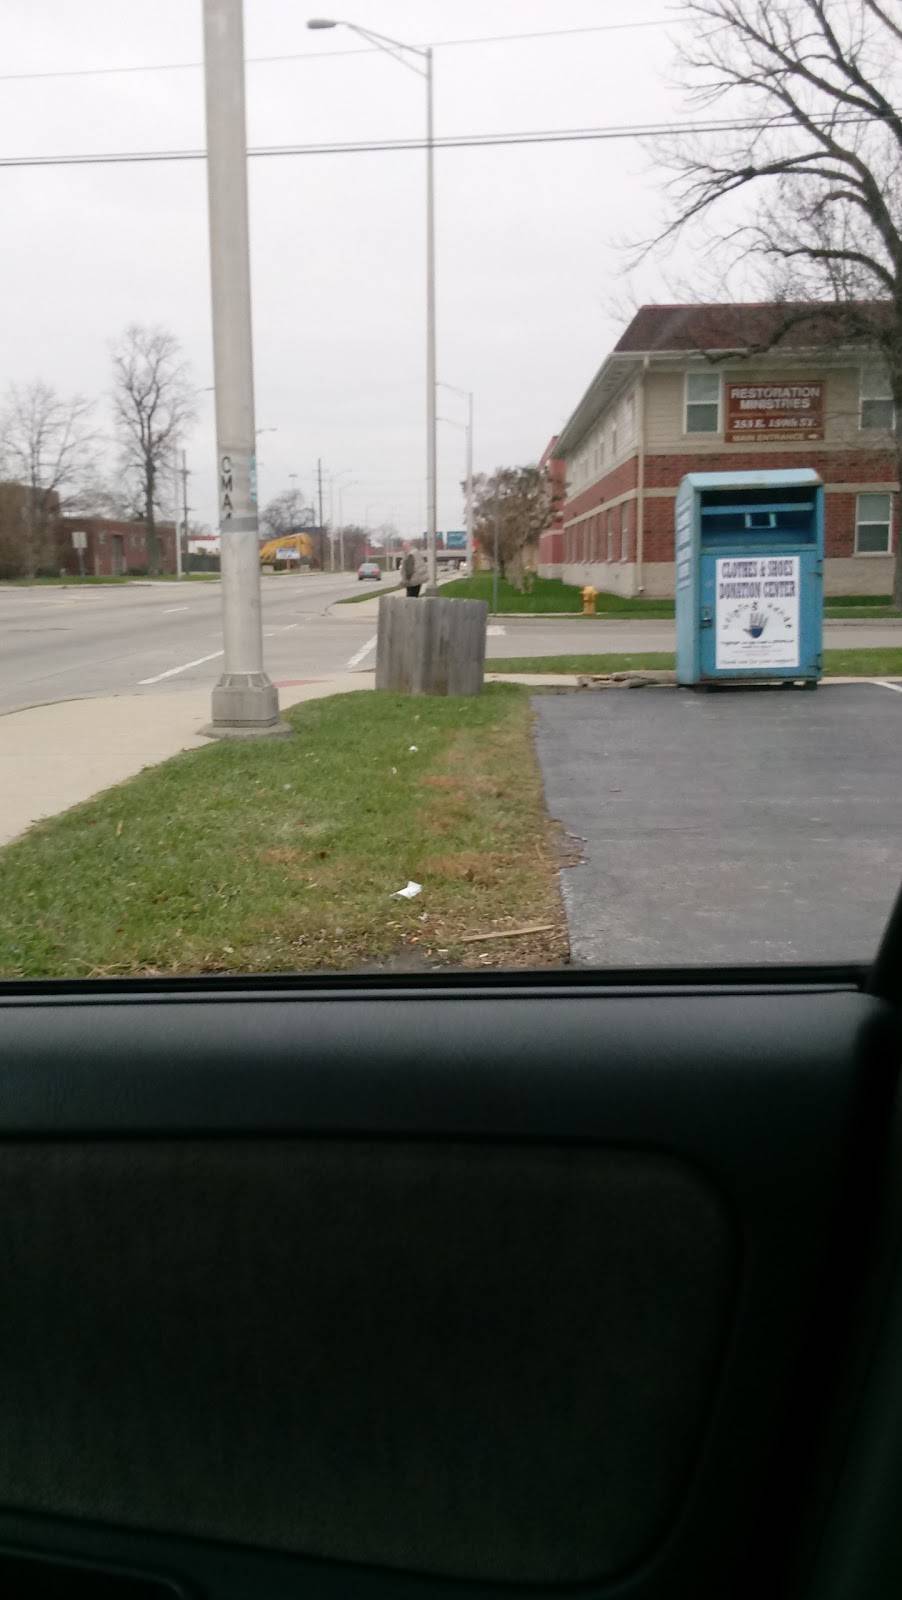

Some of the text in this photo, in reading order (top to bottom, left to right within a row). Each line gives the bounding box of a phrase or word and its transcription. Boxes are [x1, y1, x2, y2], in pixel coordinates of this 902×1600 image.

[731, 387, 820, 399] RESTORATION
[739, 398, 811, 410] MINISTRIES
[757, 433, 805, 441] ENTRANCE
[721, 560, 793, 578] CLOTHES & SHOES
[719, 581, 795, 599] DONATION CENTER
